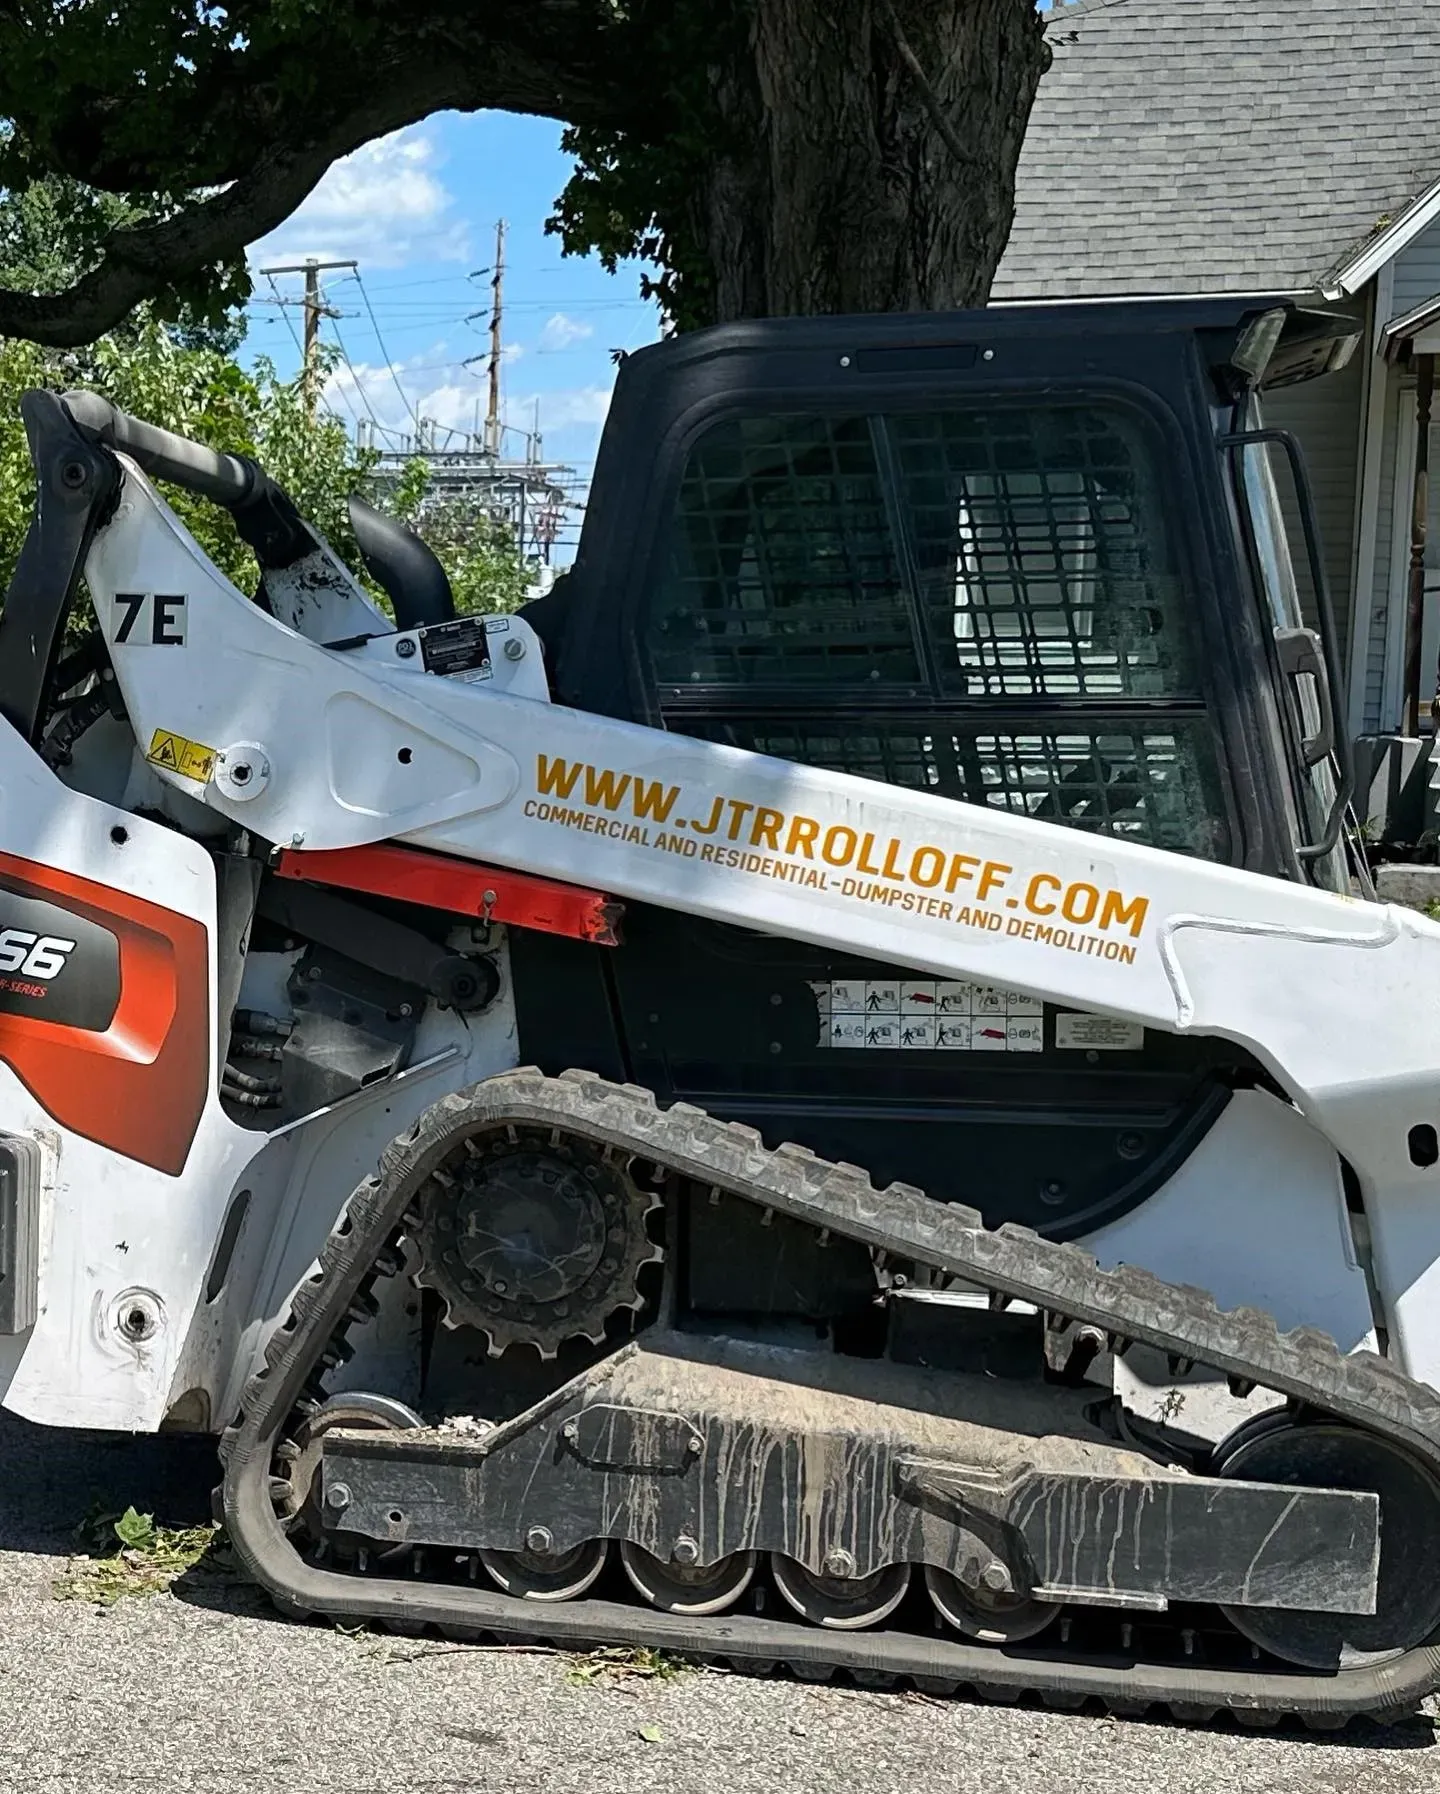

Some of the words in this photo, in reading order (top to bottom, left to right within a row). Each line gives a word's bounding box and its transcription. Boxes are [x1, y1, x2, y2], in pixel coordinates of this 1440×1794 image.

[114, 593, 185, 646] 7E
[524, 799, 650, 847] COMMERCIAL
[654, 831, 698, 858] AND
[700, 843, 952, 921] RESIDENTIAL-DUMPSTER
[956, 906, 1002, 931] AND
[1006, 917, 1138, 966] DEMOLITION
[537, 753, 1149, 938] WWW.JTRROLLOFF.COM
